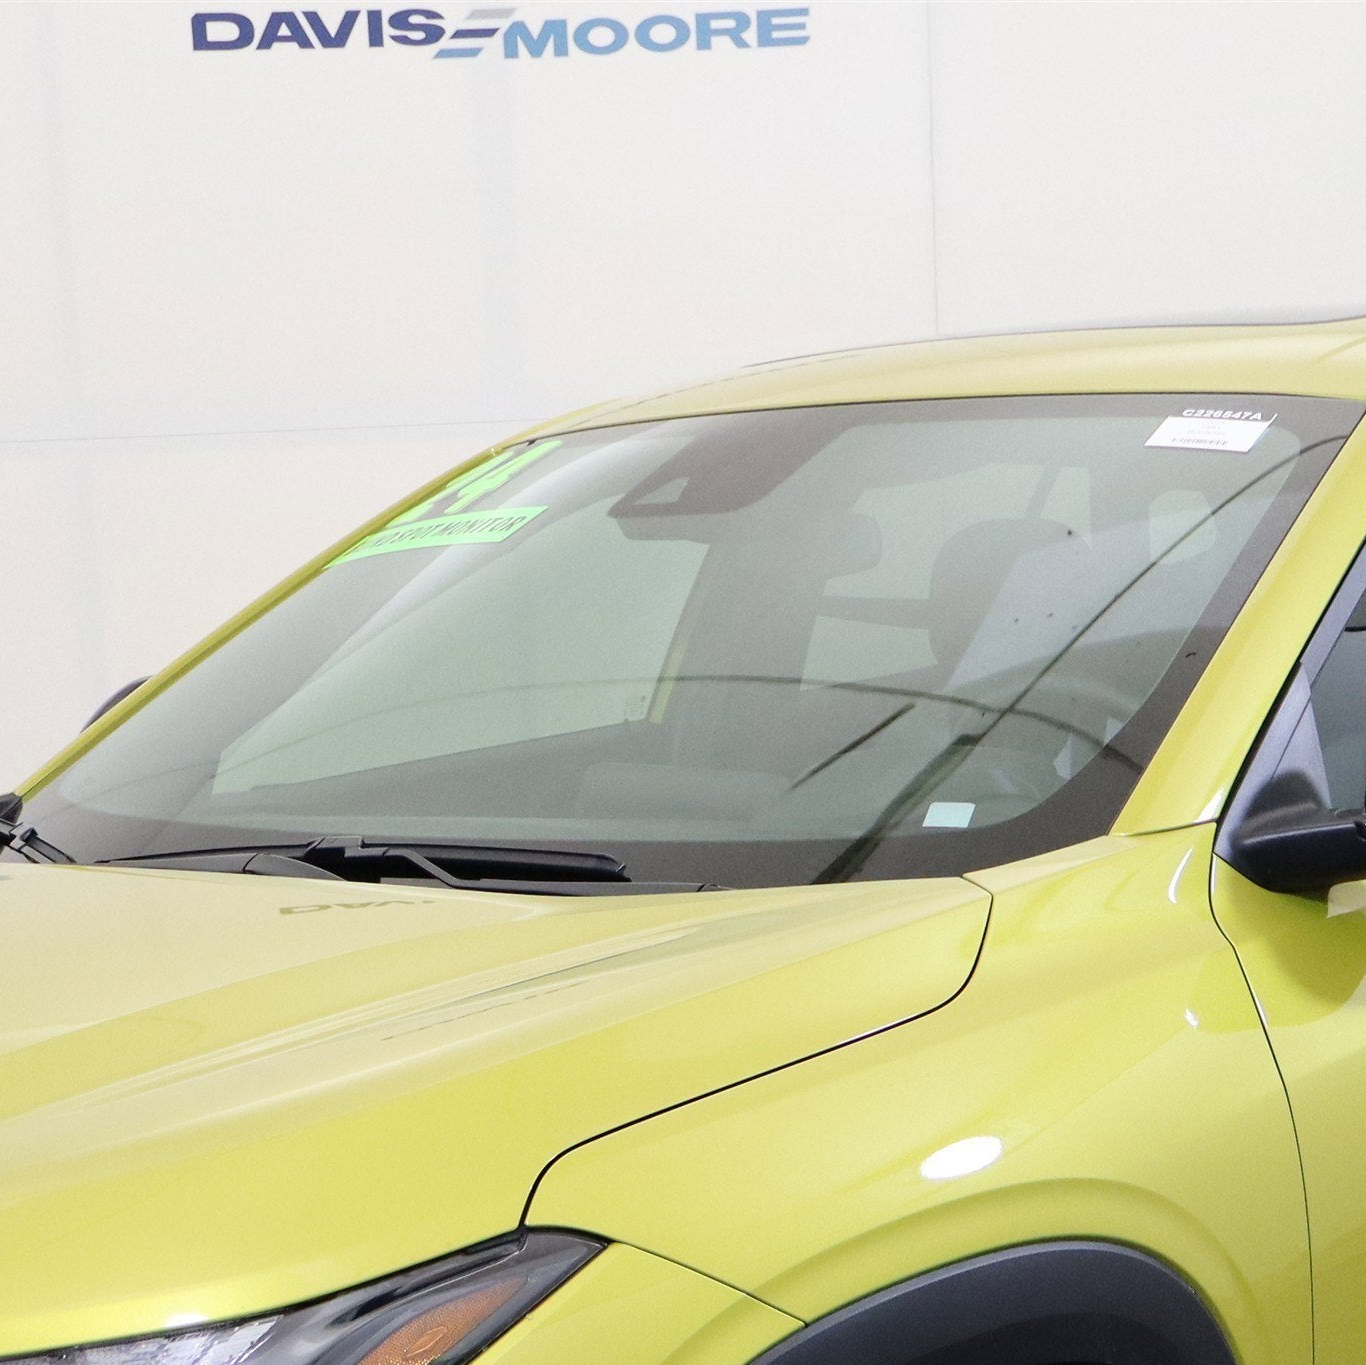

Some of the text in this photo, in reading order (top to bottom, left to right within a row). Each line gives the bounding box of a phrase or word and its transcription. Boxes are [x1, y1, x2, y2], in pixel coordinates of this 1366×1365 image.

[192, 8, 810, 60] DAVIS MOORE
[427, 514, 530, 537] MONITOR
